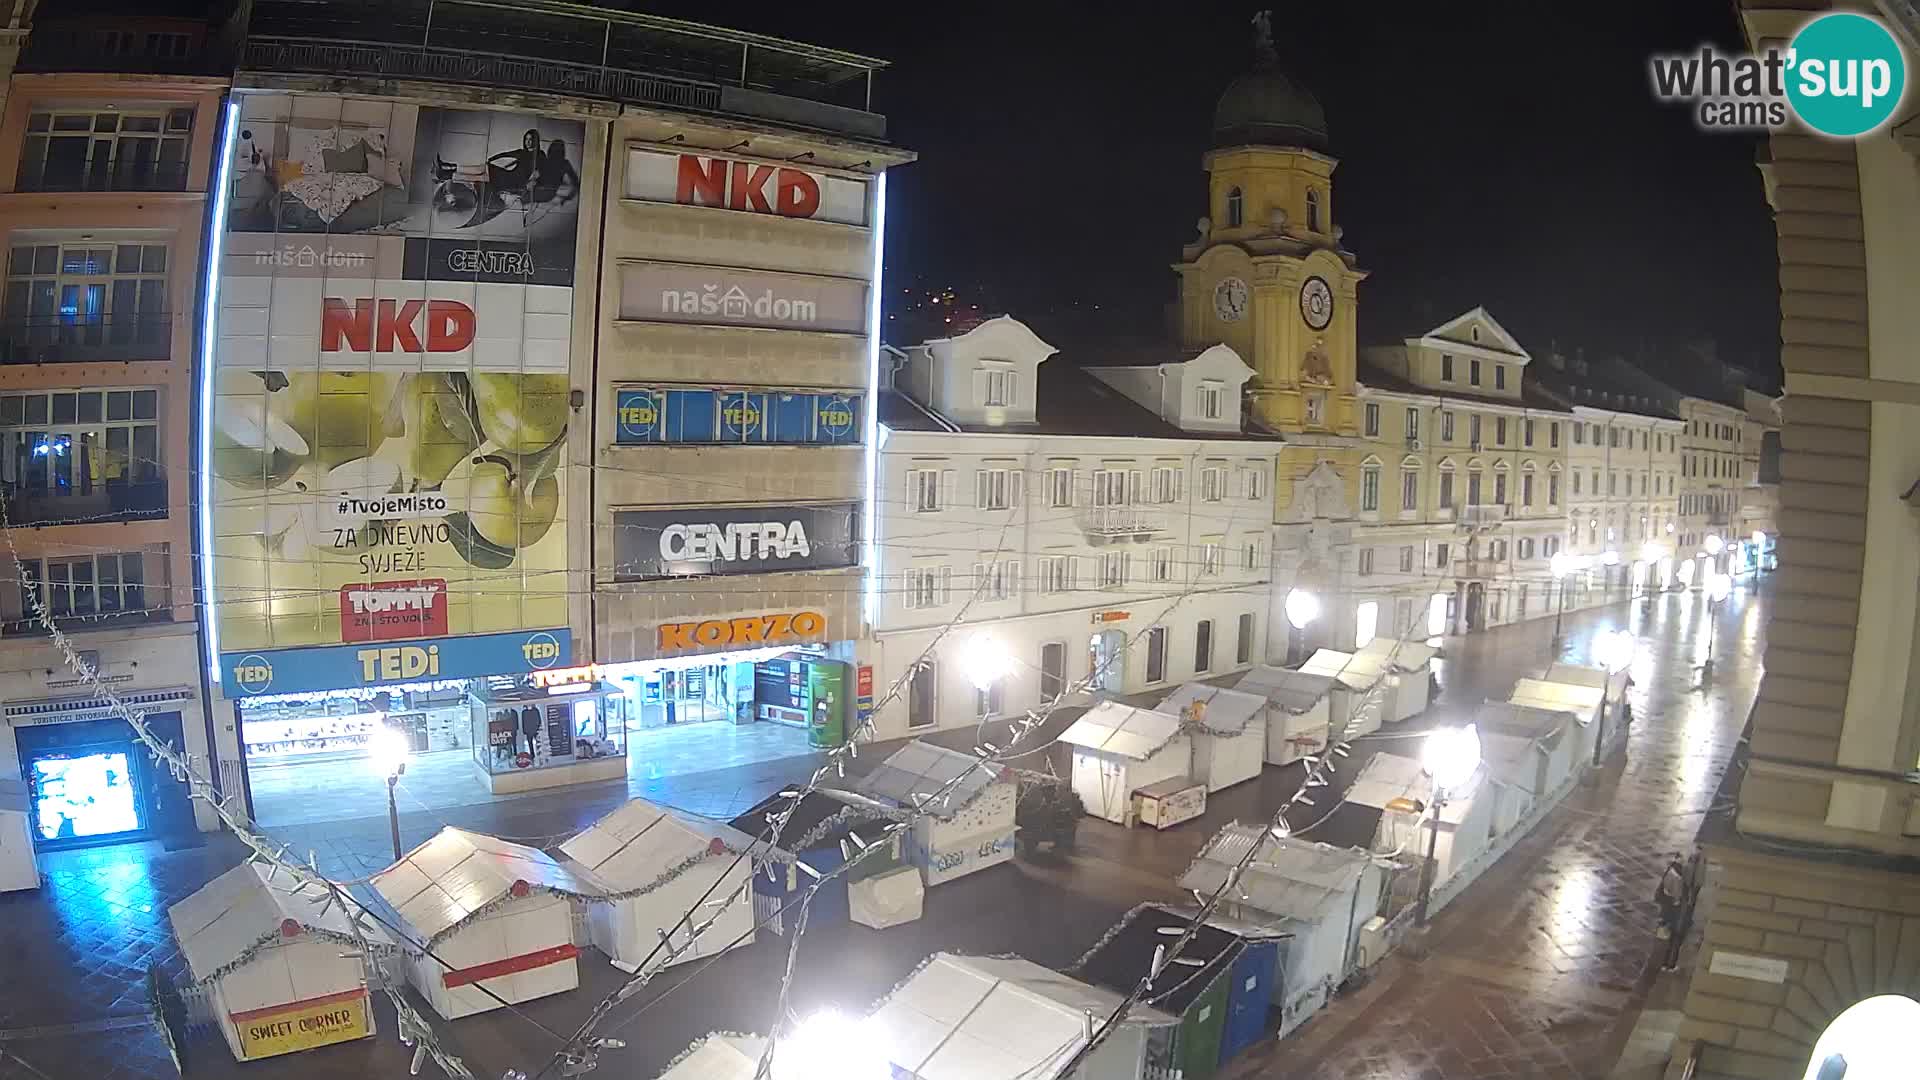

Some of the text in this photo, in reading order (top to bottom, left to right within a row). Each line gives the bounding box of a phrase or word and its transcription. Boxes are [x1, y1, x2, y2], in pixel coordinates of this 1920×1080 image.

[675, 153, 820, 219] NKD
[255, 244, 366, 269] naš dom
[448, 249, 534, 275] CENTRA
[662, 284, 816, 321] naš dom
[320, 296, 477, 354] NKD
[338, 496, 446, 516] #TvojeMisto
[333, 523, 450, 548] ZA DNEVNO
[659, 520, 810, 561] CENTRA
[360, 547, 426, 575] SVJEŽE
[659, 611, 826, 650] KORZO
[357, 645, 440, 682] TEDi
[522, 641, 560, 660] TEDi
[233, 665, 273, 683] TEDi
[76, 708, 129, 721] INFORMATI
[250, 1021, 292, 1041] SWEET
